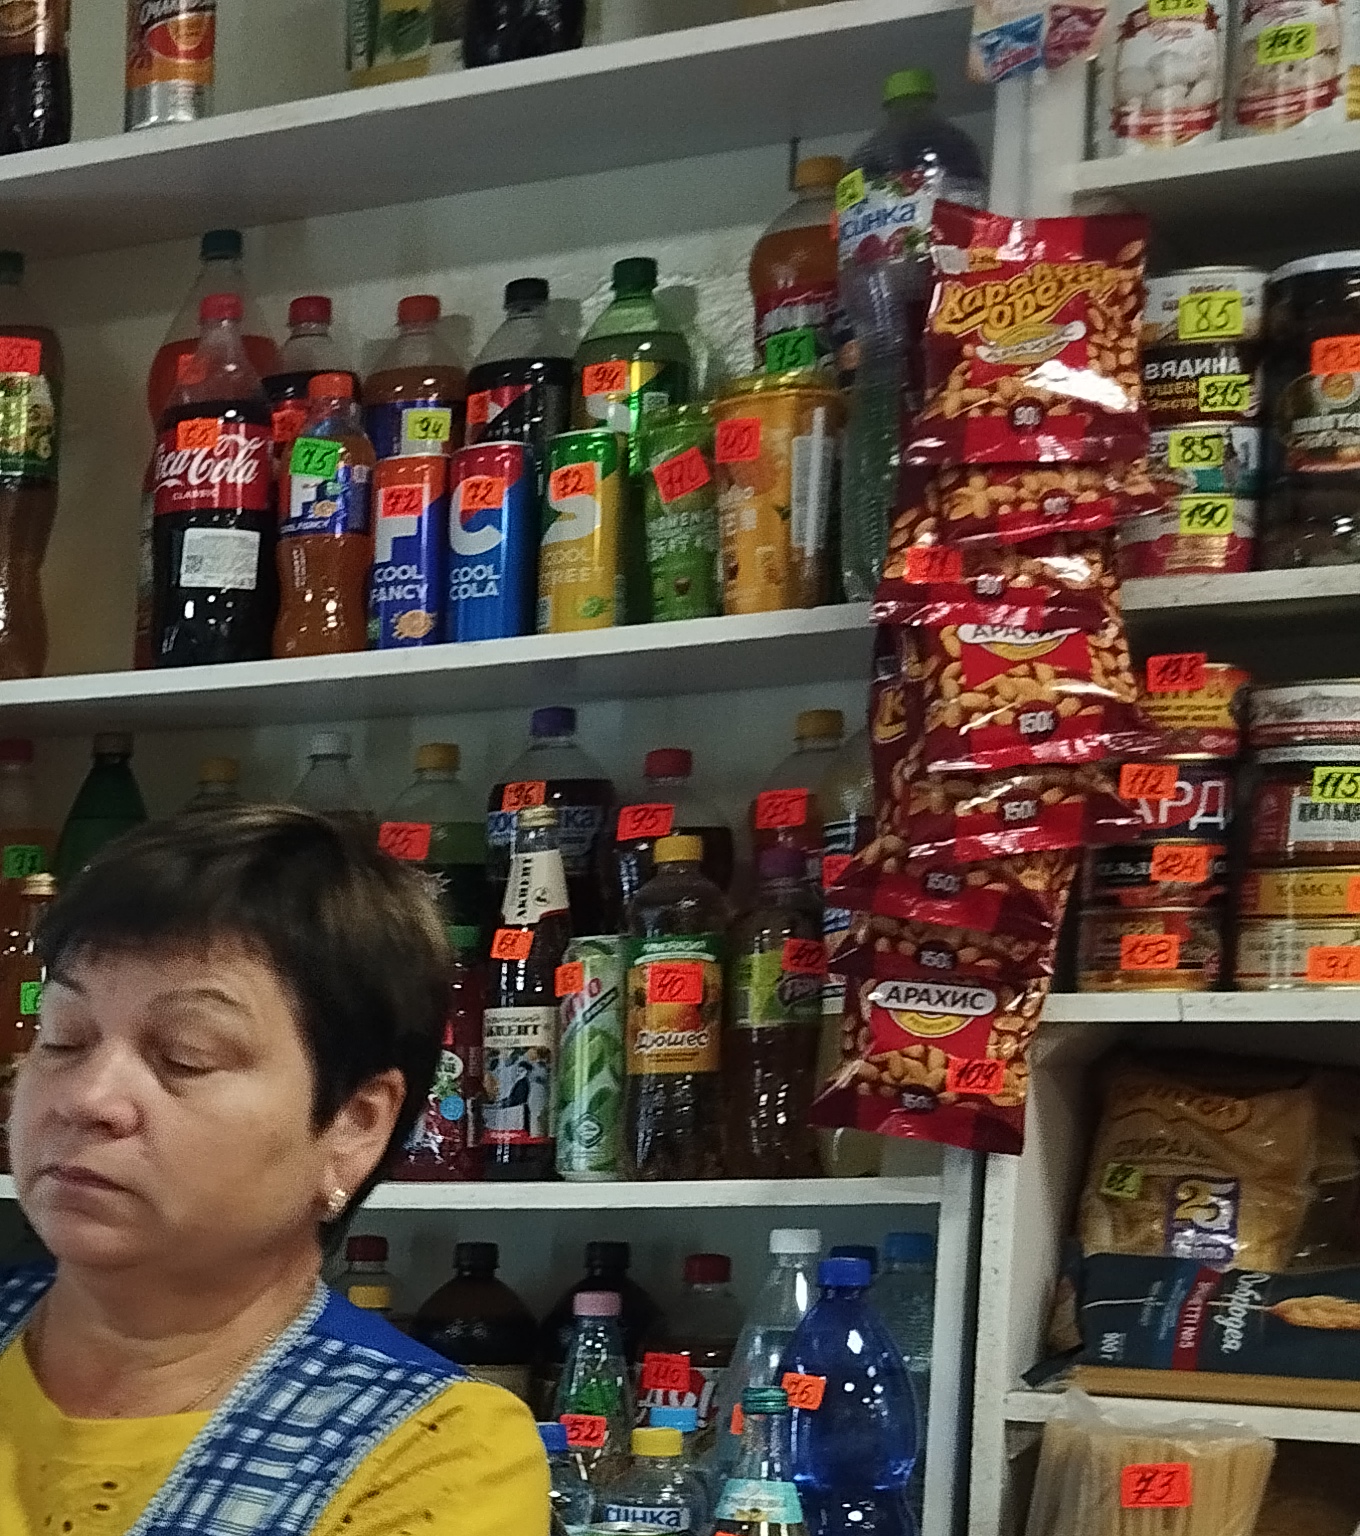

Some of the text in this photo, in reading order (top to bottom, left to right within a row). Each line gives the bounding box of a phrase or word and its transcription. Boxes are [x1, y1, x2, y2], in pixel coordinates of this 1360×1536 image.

[1194, 296, 1238, 333] 85
[373, 564, 427, 584] COOL
[448, 564, 501, 584] COOL
[370, 584, 428, 604] FANCY
[448, 580, 500, 602] COLA
[884, 985, 988, 1012] АРАХИС
